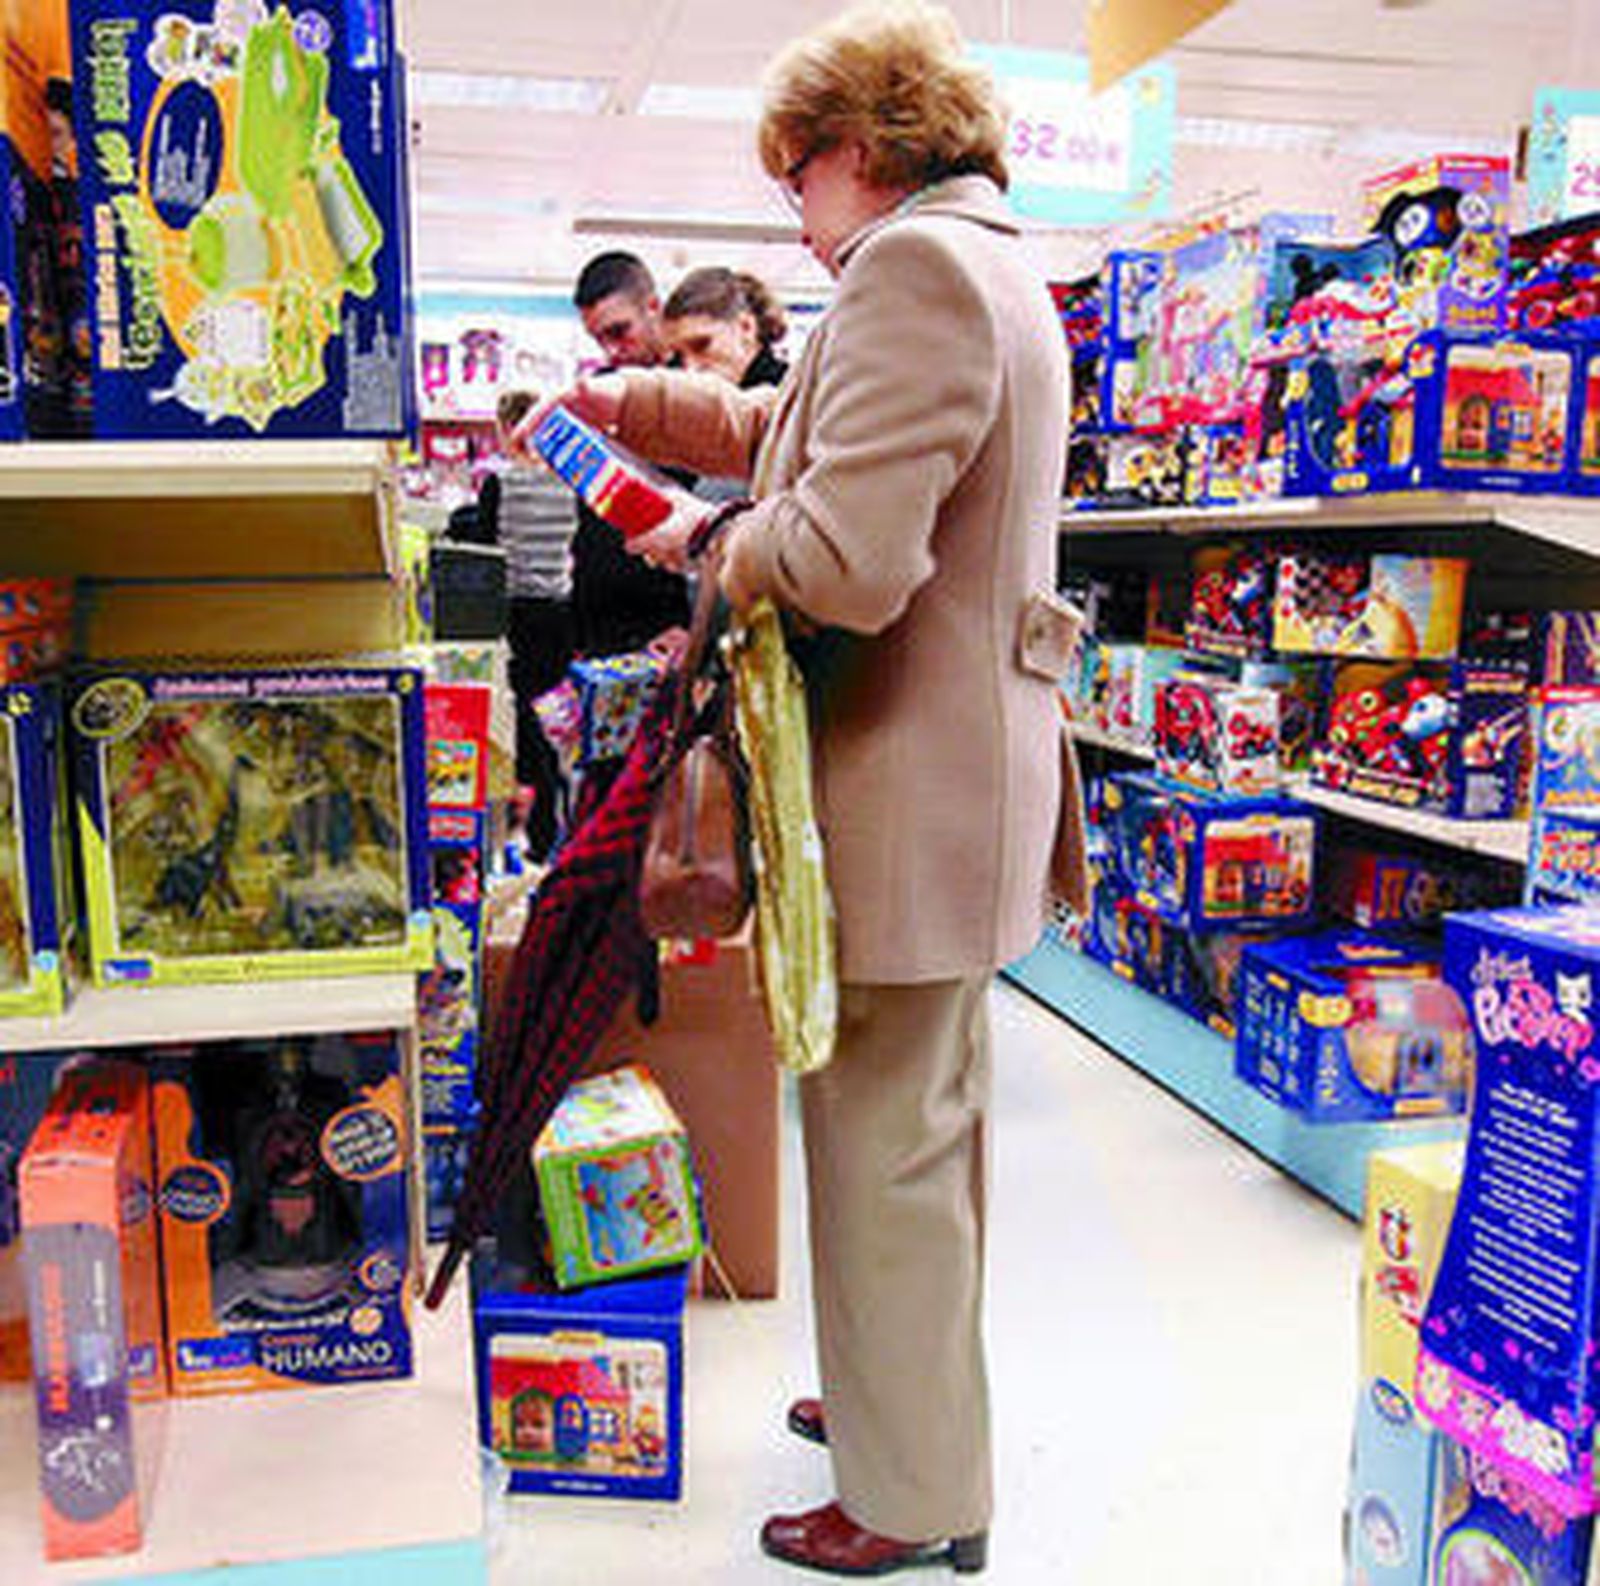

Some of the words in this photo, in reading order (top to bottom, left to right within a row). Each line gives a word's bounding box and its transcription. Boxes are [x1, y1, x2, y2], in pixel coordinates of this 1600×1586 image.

[1011, 118, 1060, 159] 32
[1570, 162, 1600, 197] 2
[261, 1341, 393, 1373] HUMANO
